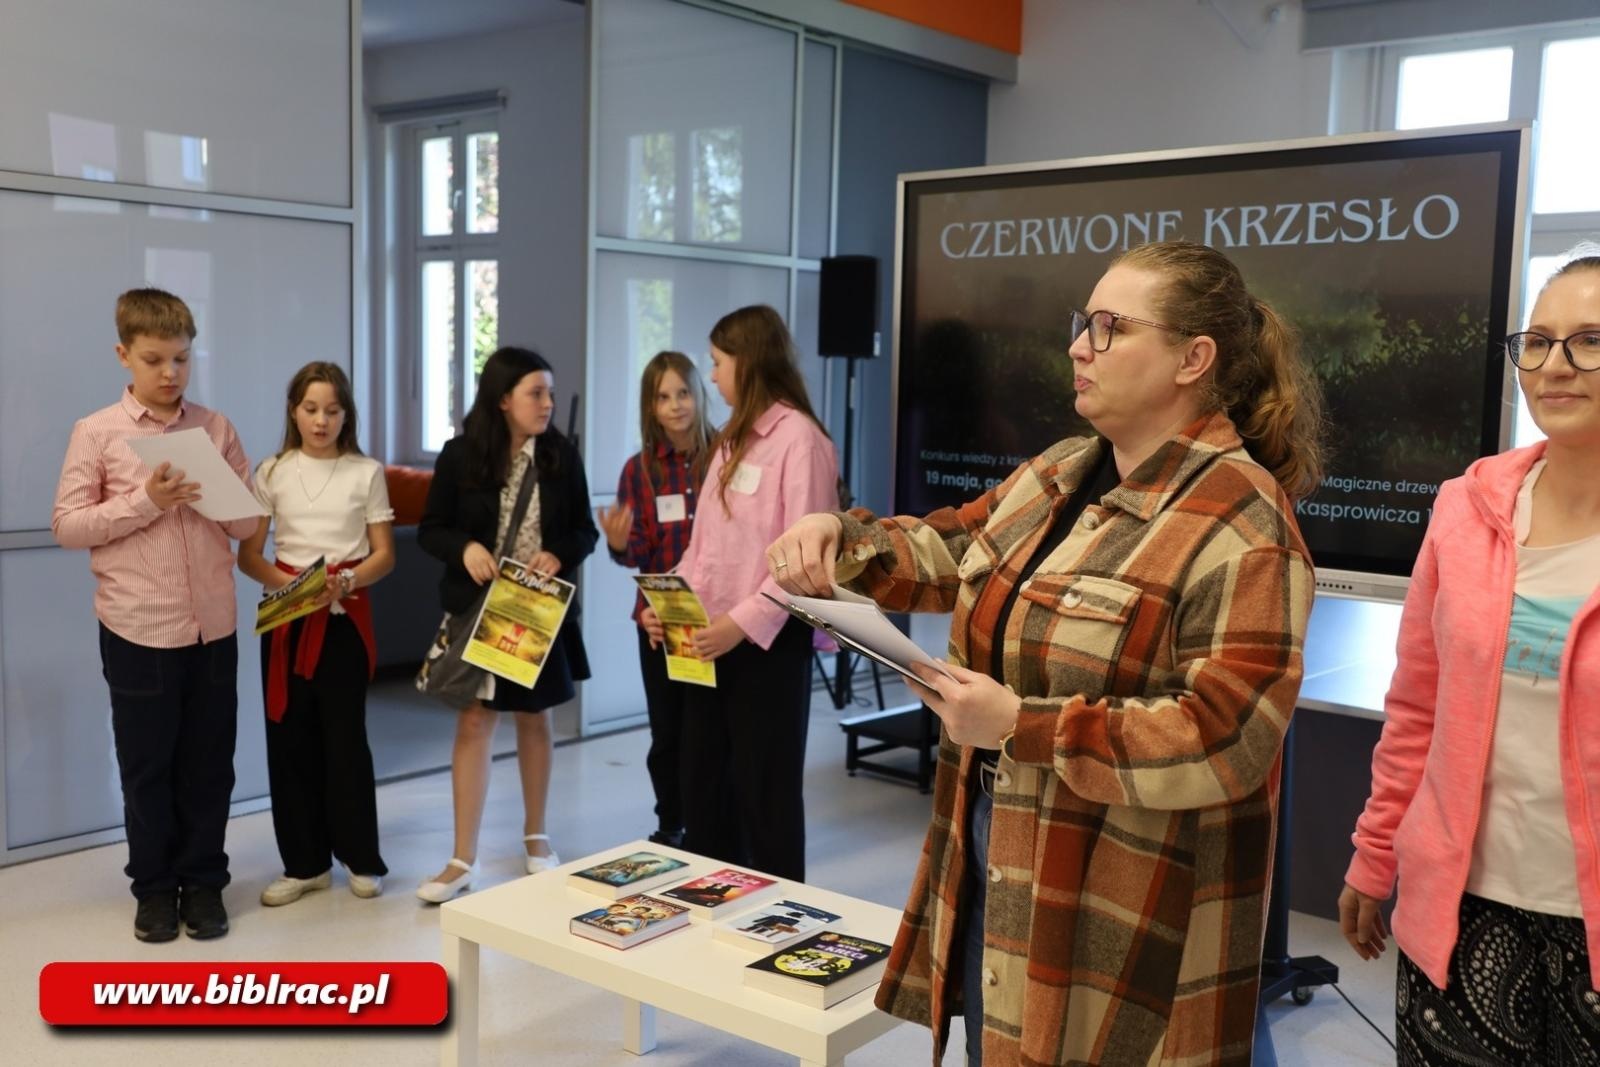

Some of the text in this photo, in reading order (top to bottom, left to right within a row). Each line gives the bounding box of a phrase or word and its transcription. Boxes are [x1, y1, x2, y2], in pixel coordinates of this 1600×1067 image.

[940, 194, 1460, 259] CZERWONE KRZESŁO
[920, 449, 960, 463] Konkurs
[962, 451, 997, 467] wiedzy
[925, 470, 940, 485] 19
[941, 473, 982, 492] maja,
[1320, 475, 1392, 493] Magiczne
[1295, 499, 1420, 524] Kasprowicza
